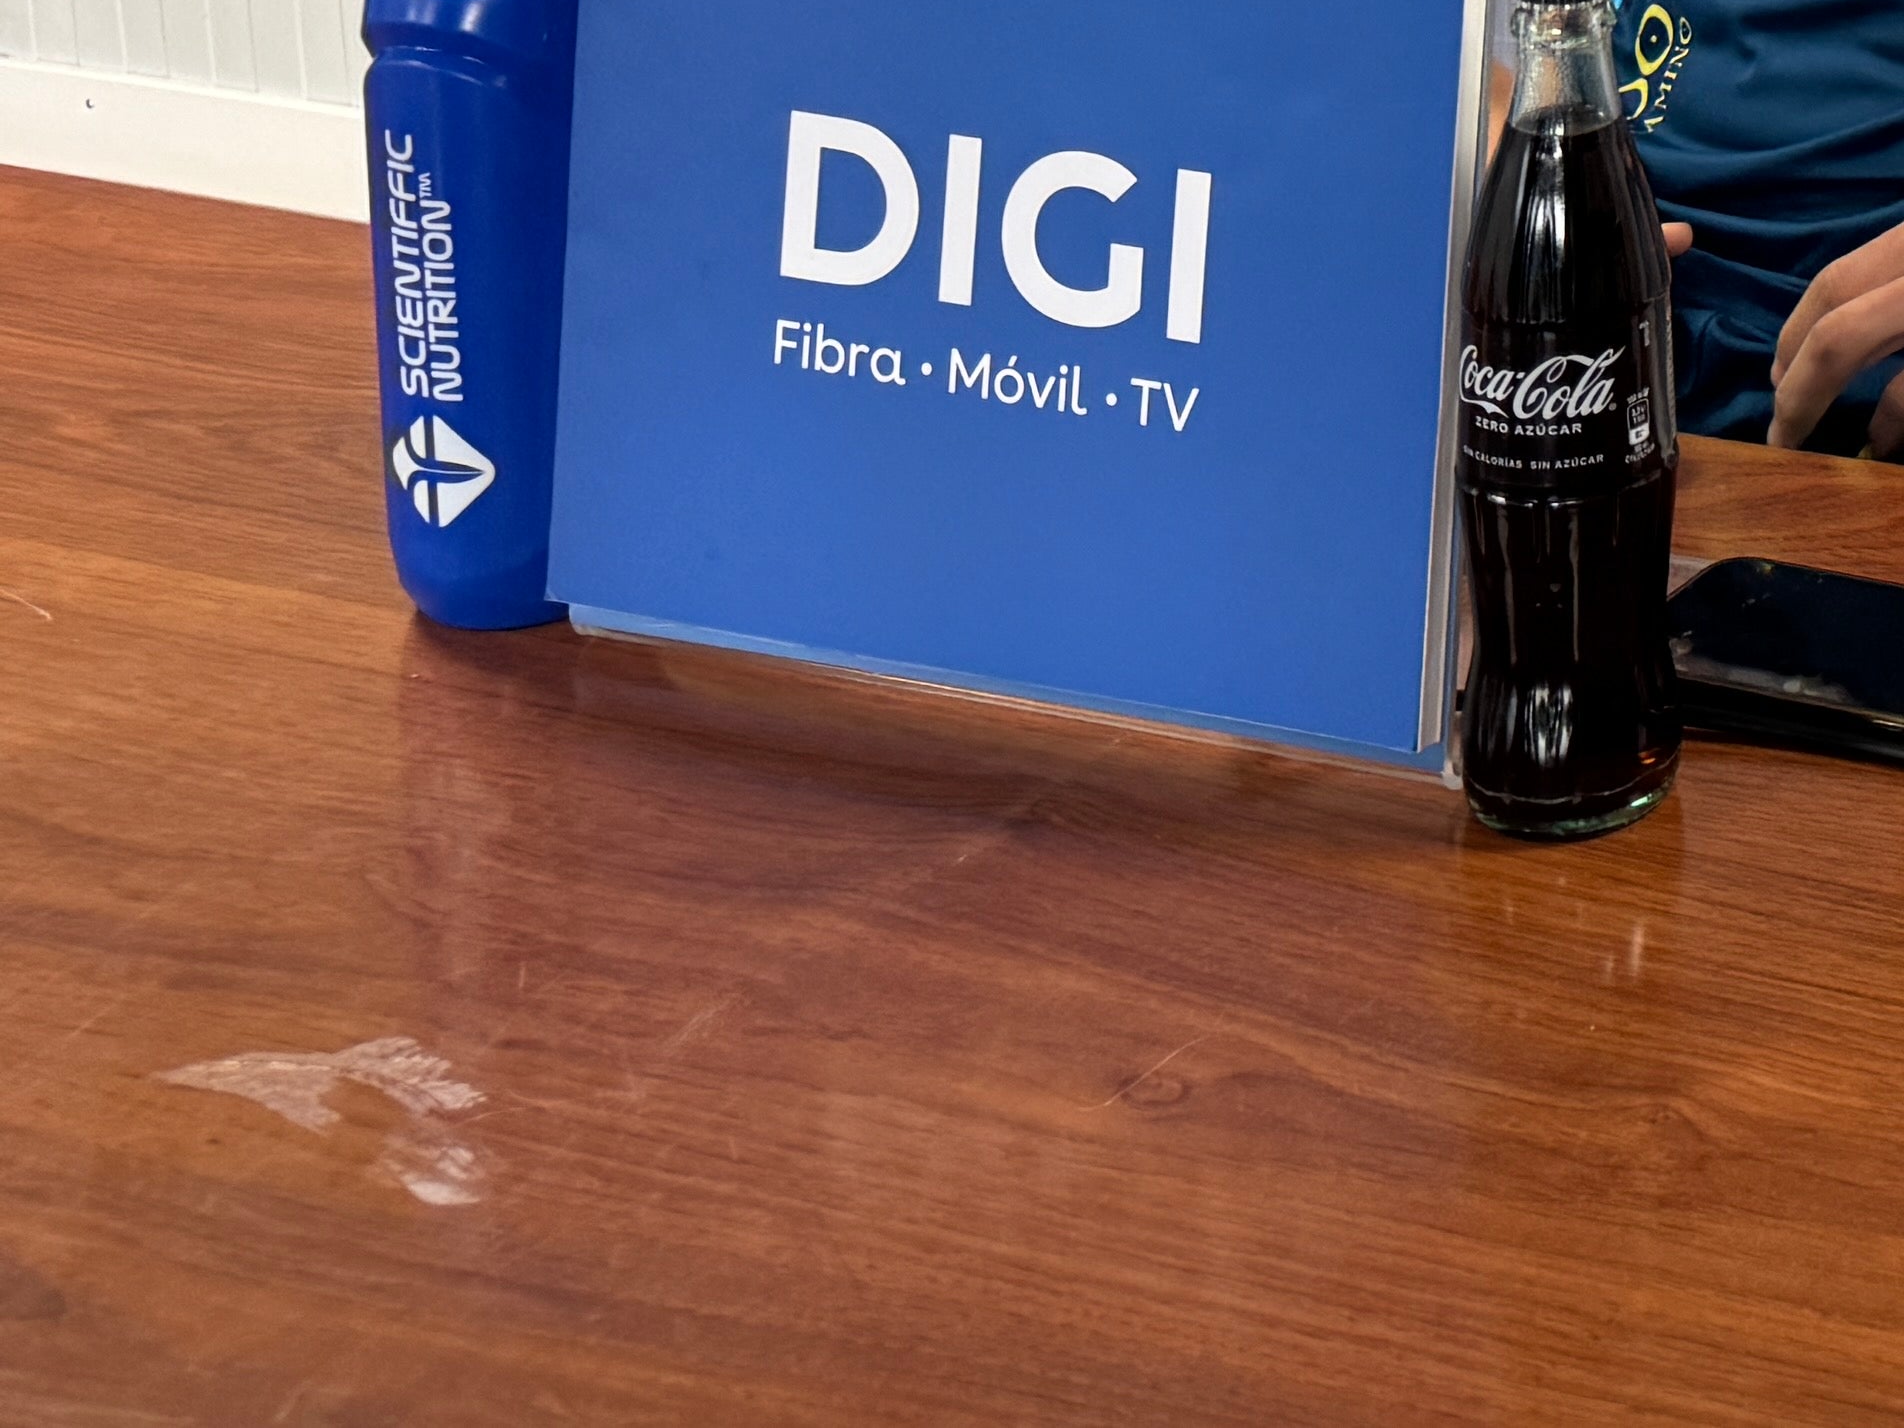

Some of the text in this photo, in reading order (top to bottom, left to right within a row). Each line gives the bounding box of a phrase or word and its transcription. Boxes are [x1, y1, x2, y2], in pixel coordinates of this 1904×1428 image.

[384, 128, 430, 398] SCIENTIFFIC
[780, 110, 1211, 344] DIGI
[774, 319, 1200, 432] Fibra Móvil TV
[1460, 344, 1626, 420] Coca-Cola
[1475, 416, 1582, 436] ZERO AZÚCAR
[1475, 450, 1522, 469] CALORÍAS
[1530, 457, 1550, 470] SIN
[1555, 453, 1604, 470] AZÚCAR
